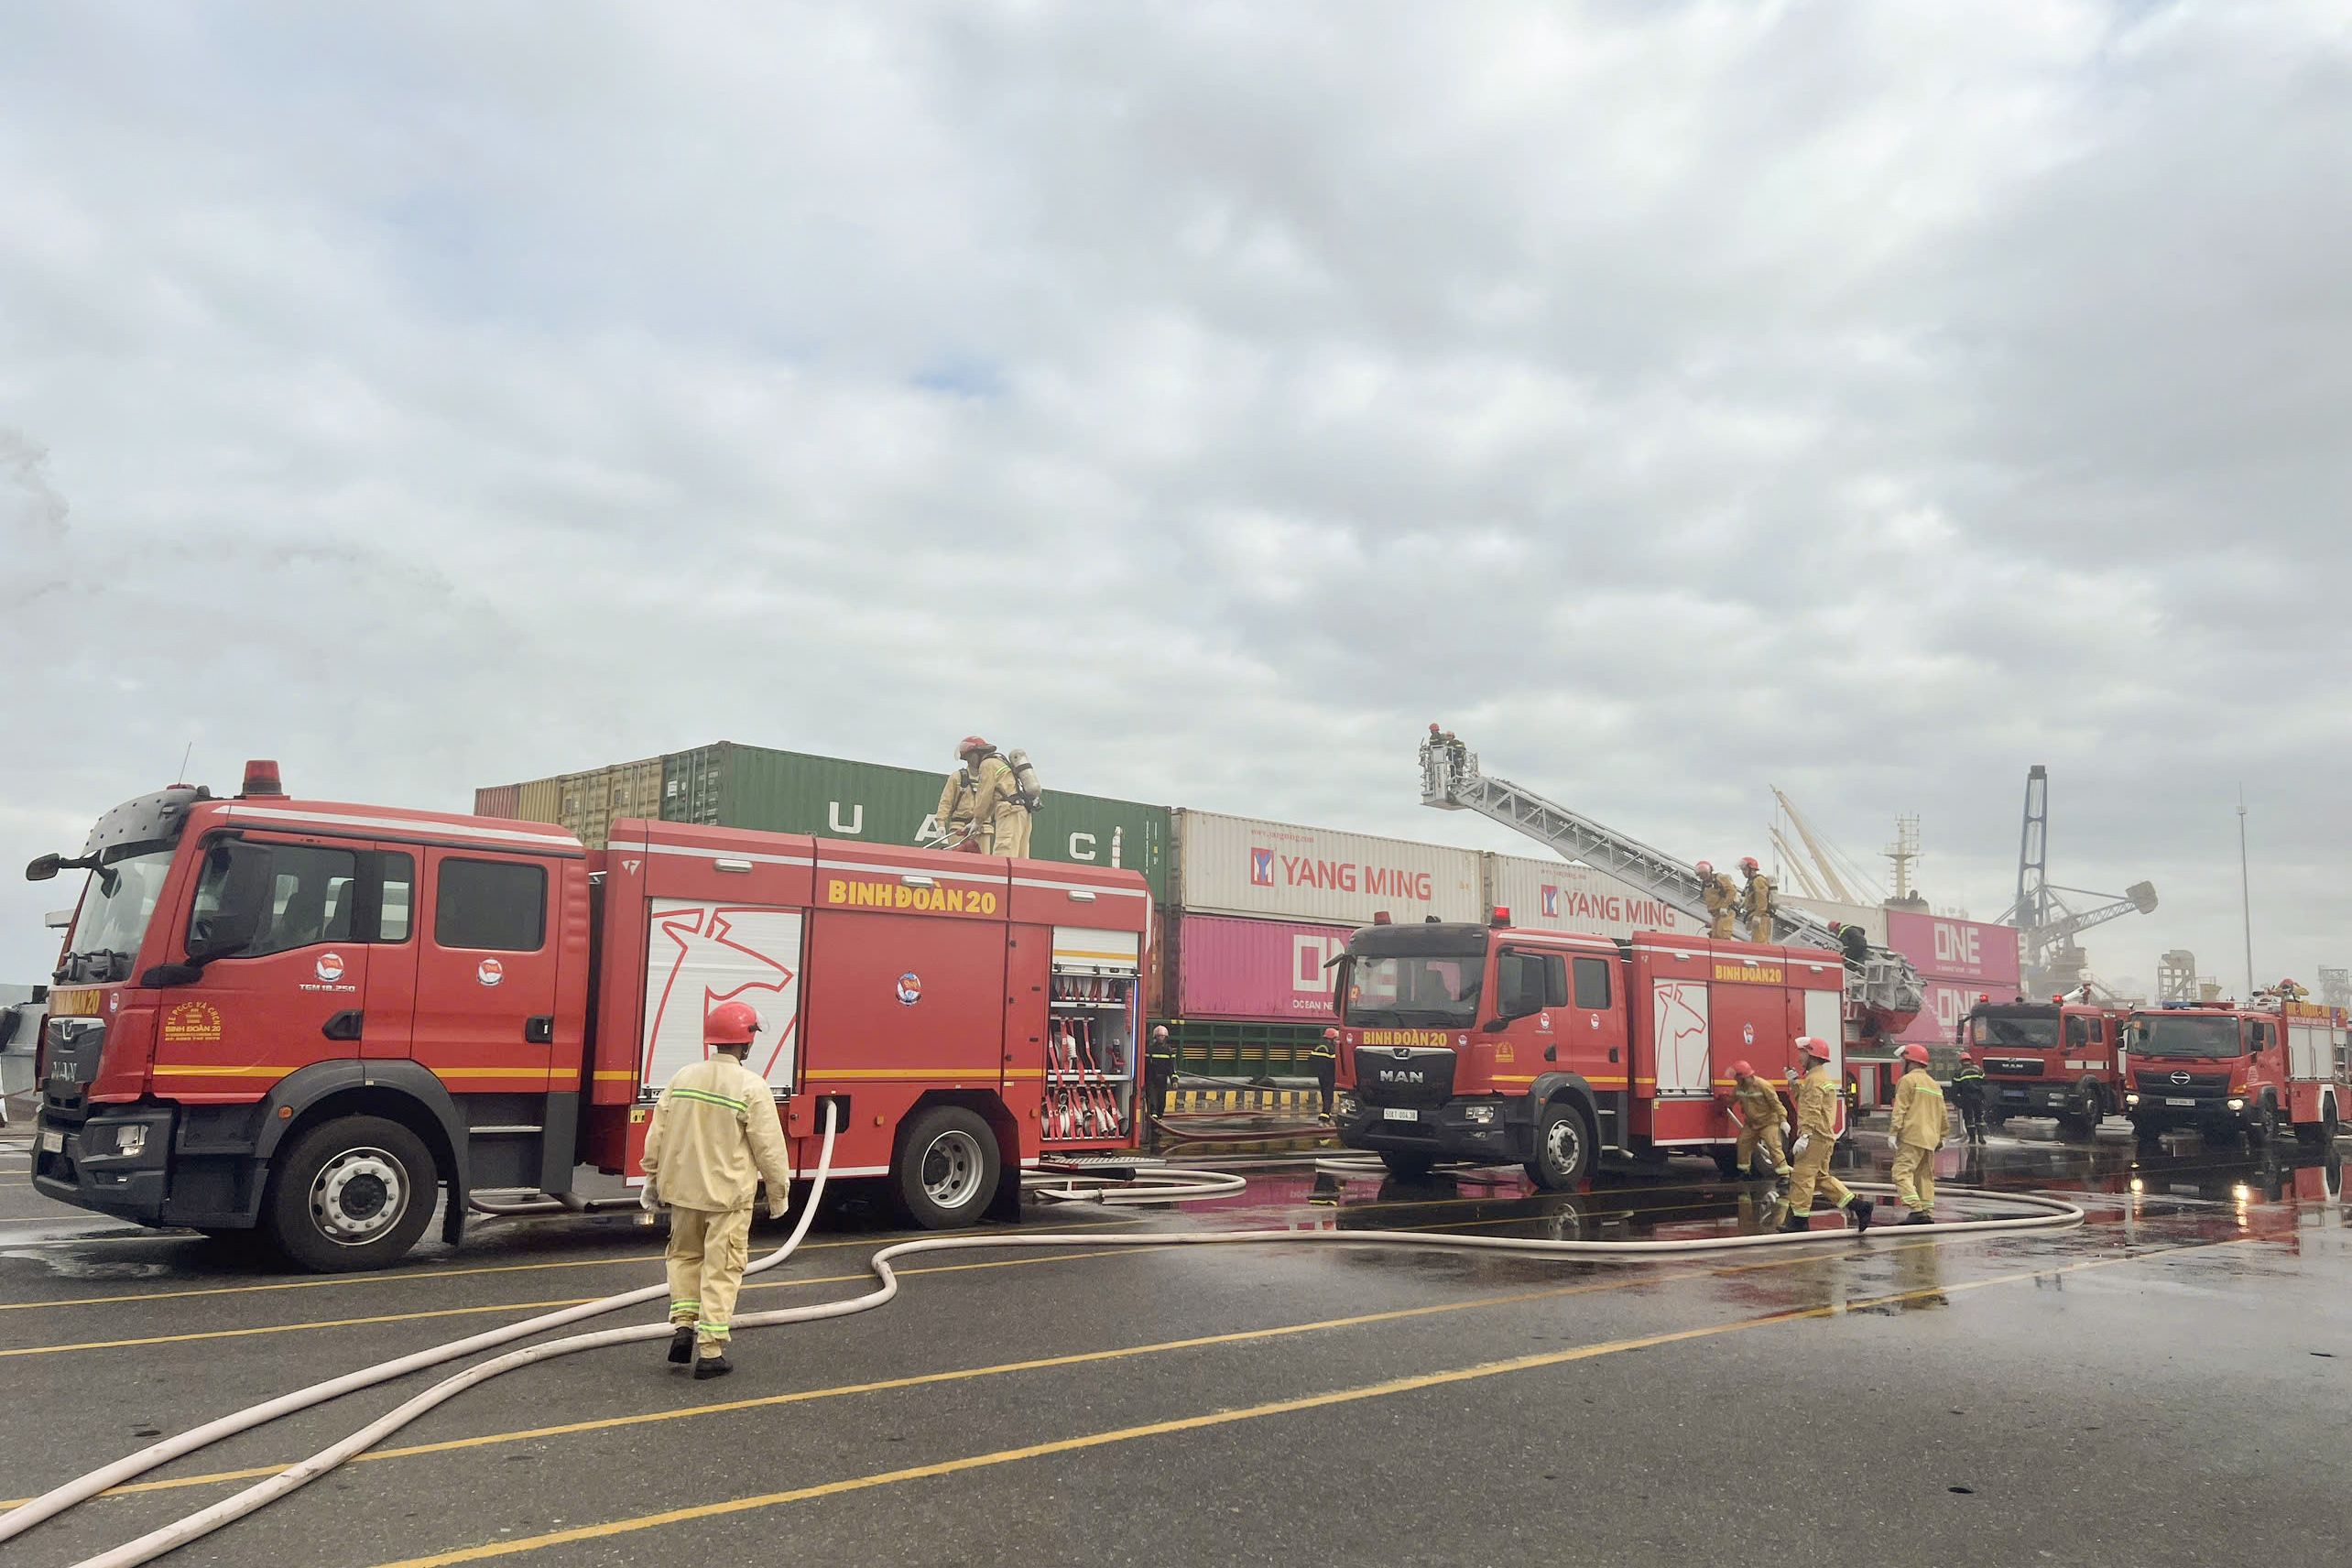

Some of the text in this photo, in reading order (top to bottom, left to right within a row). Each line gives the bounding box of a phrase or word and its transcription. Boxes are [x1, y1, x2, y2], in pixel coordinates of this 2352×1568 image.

[1280, 855, 1432, 901] YANG MING
[828, 879, 996, 914] BINH ĐOÀN 20
[1564, 890, 1675, 927] YANG MING
[1933, 921, 1980, 964] ONE
[1715, 964, 1740, 981] BINH
[1769, 968, 1782, 983] 20
[1293, 999, 1321, 1009] OCEAN
[1363, 1029, 1447, 1047] BINH ĐOÀN 20
[1379, 1070, 1424, 1083] MAN
